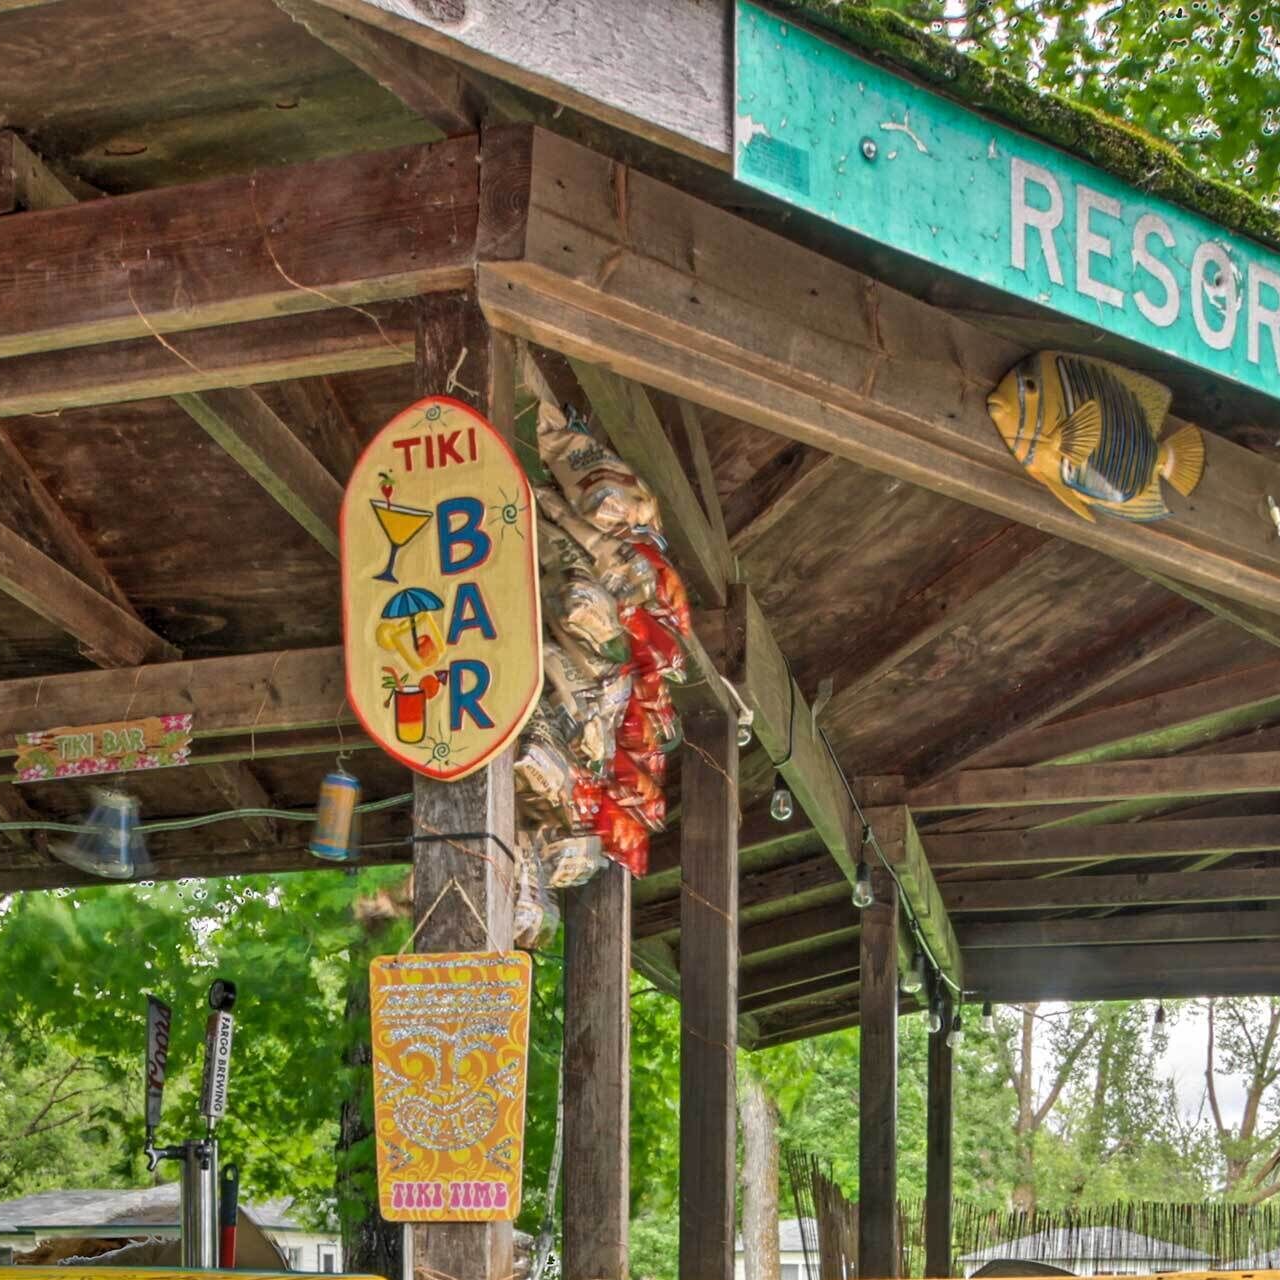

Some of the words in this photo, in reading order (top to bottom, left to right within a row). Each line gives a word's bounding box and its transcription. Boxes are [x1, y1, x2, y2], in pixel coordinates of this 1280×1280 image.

[393, 428, 478, 472] TIKI
[436, 496, 497, 733] BAR
[56, 732, 94, 759] TIKI
[102, 727, 146, 755] BAR
[219, 1016, 231, 1056] FARGO
[214, 1058, 228, 1112] BREWING
[392, 1181, 444, 1210] TIKI
[449, 1181, 509, 1210] TIME
